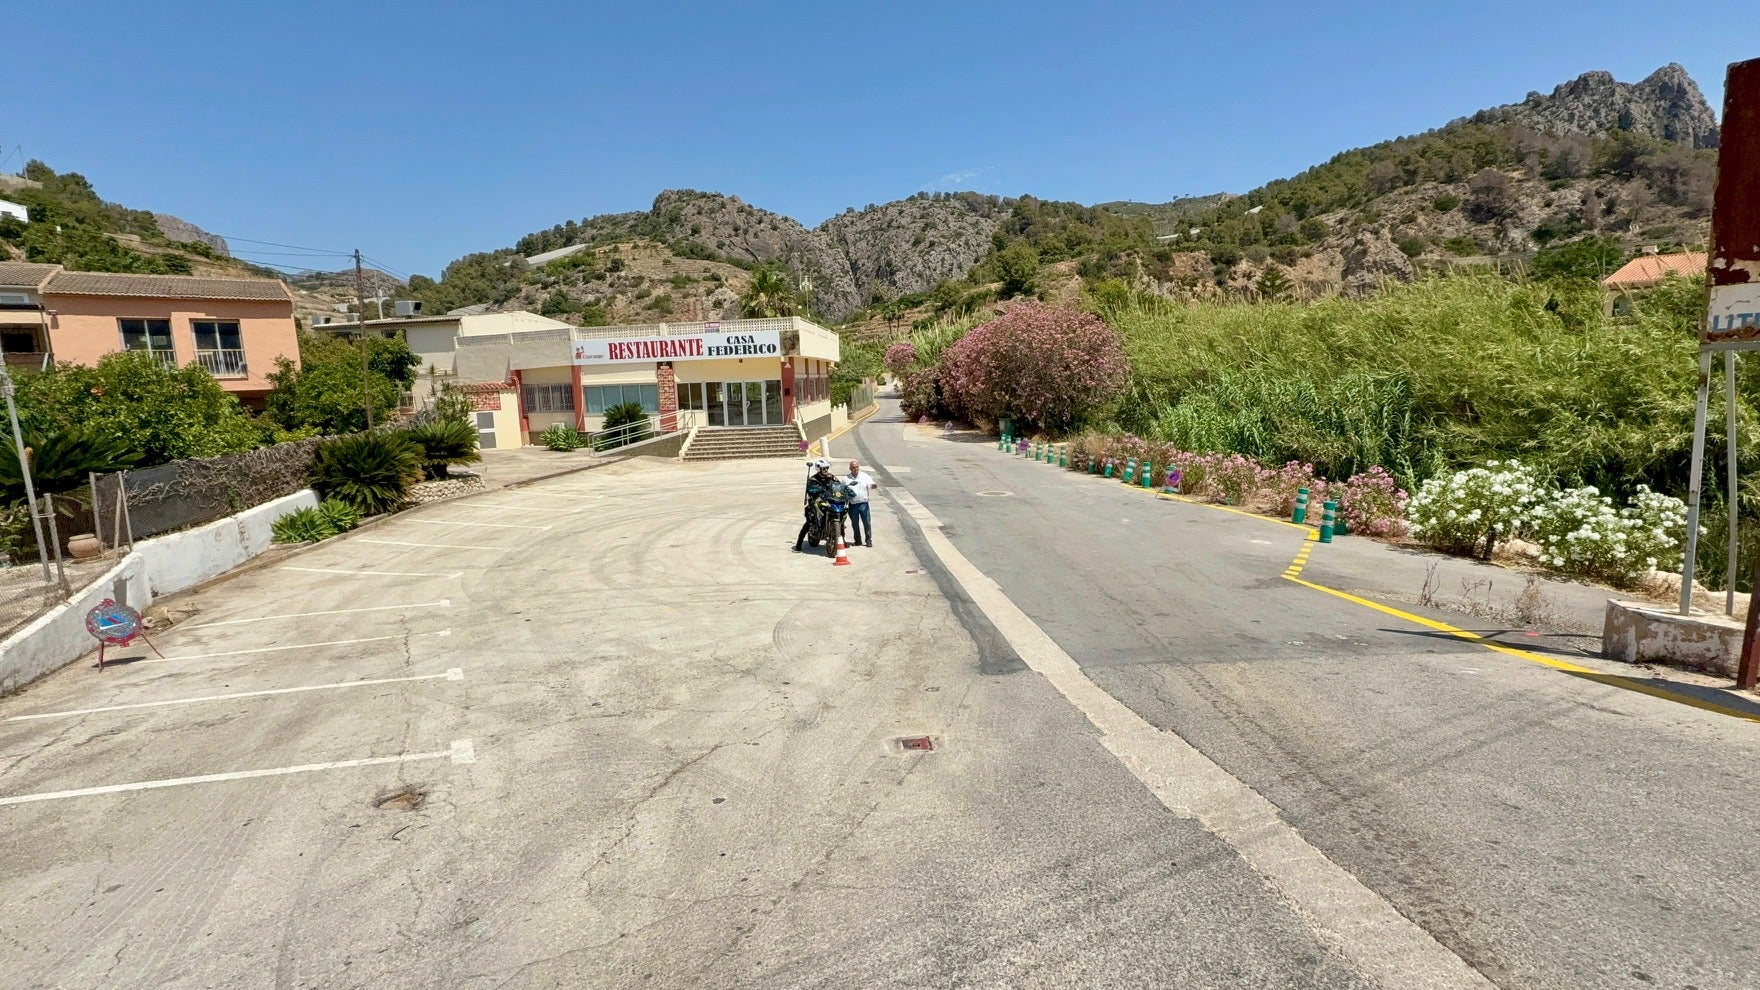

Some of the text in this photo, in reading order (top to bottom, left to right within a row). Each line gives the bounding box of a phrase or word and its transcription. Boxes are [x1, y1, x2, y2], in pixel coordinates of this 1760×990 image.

[726, 335, 755, 345] CASA
[608, 339, 704, 360] RESTAURANTE
[707, 343, 777, 356] FEDERICO
